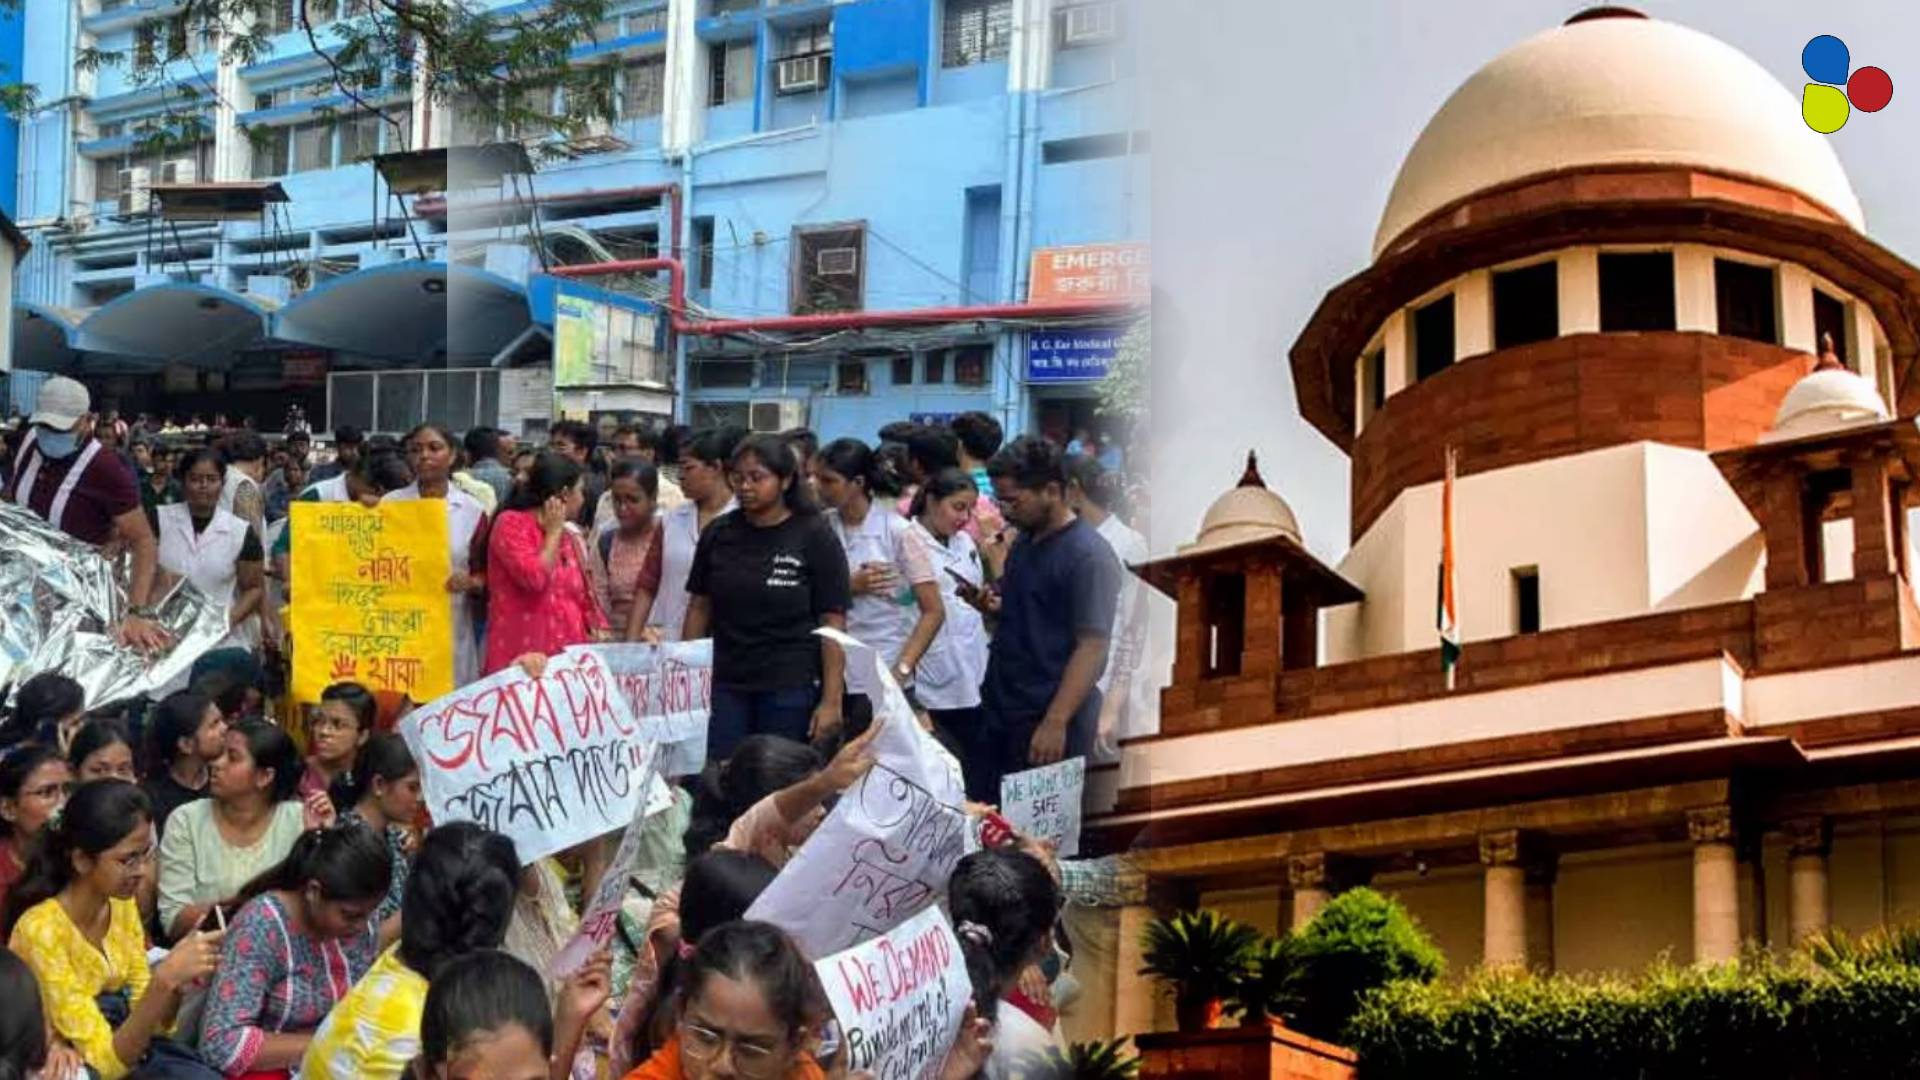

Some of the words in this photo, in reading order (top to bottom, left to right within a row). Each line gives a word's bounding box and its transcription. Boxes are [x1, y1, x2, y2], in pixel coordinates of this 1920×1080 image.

[1073, 336, 1111, 350] Medical
[420, 678, 566, 771] জবাব
[555, 652, 634, 738] চাই
[838, 954, 884, 1014] WE
[878, 924, 950, 1002] DEMAND
